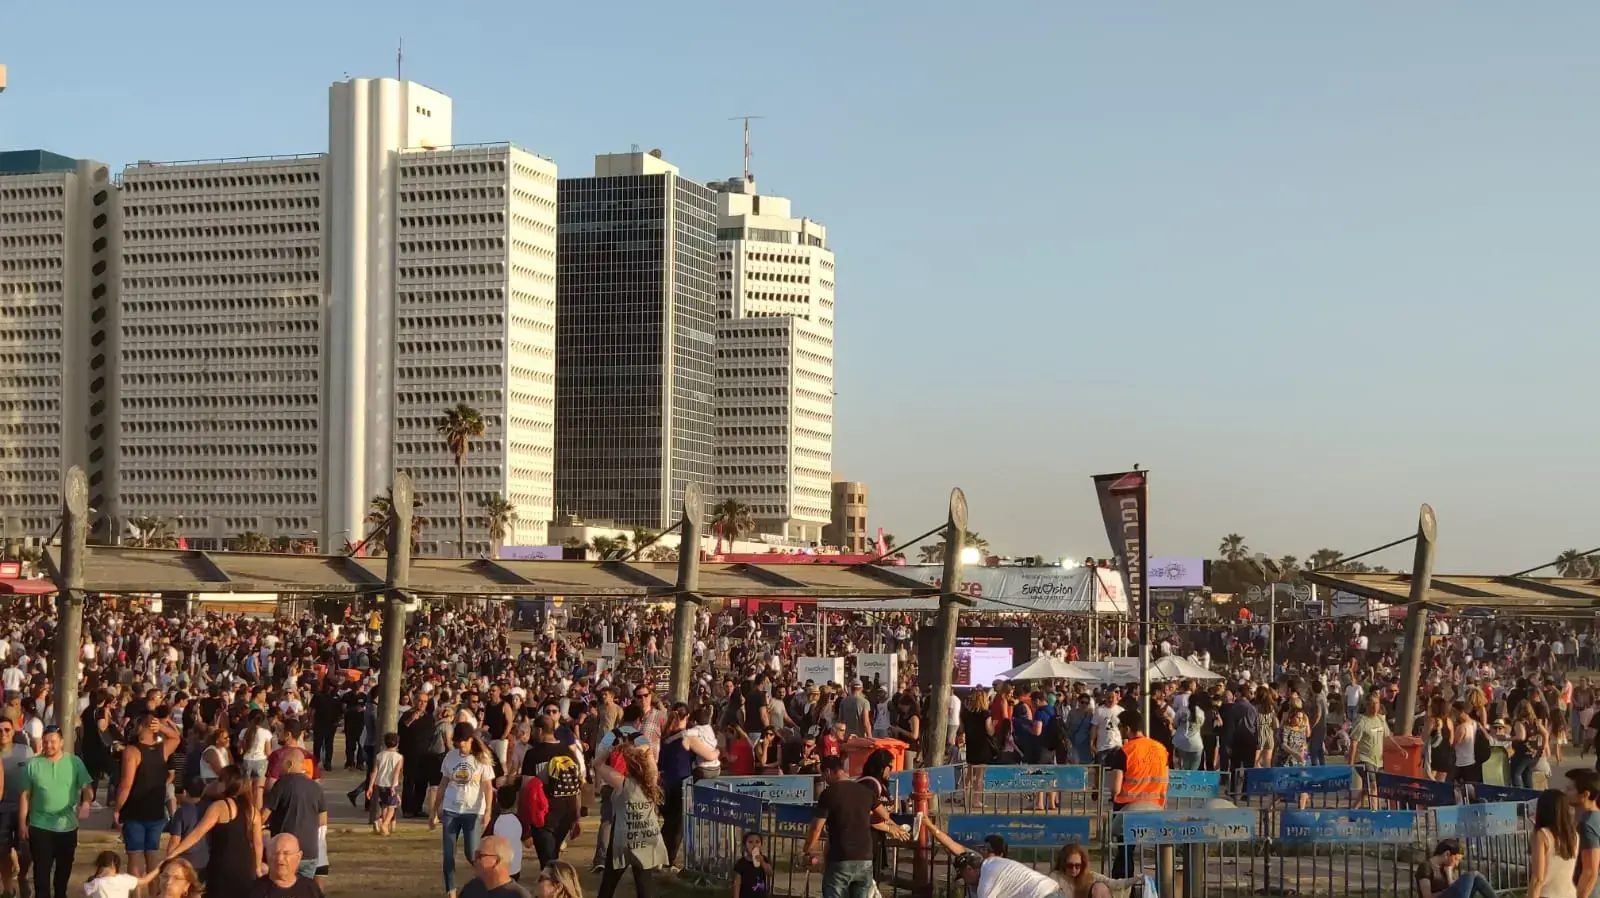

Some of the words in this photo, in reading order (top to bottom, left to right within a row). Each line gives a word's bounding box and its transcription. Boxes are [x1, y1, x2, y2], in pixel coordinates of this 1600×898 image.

[626, 800, 653, 811] TRUST
[626, 811, 644, 820] THE
[627, 831, 639, 840] OF
[627, 840, 646, 849] LIFE
